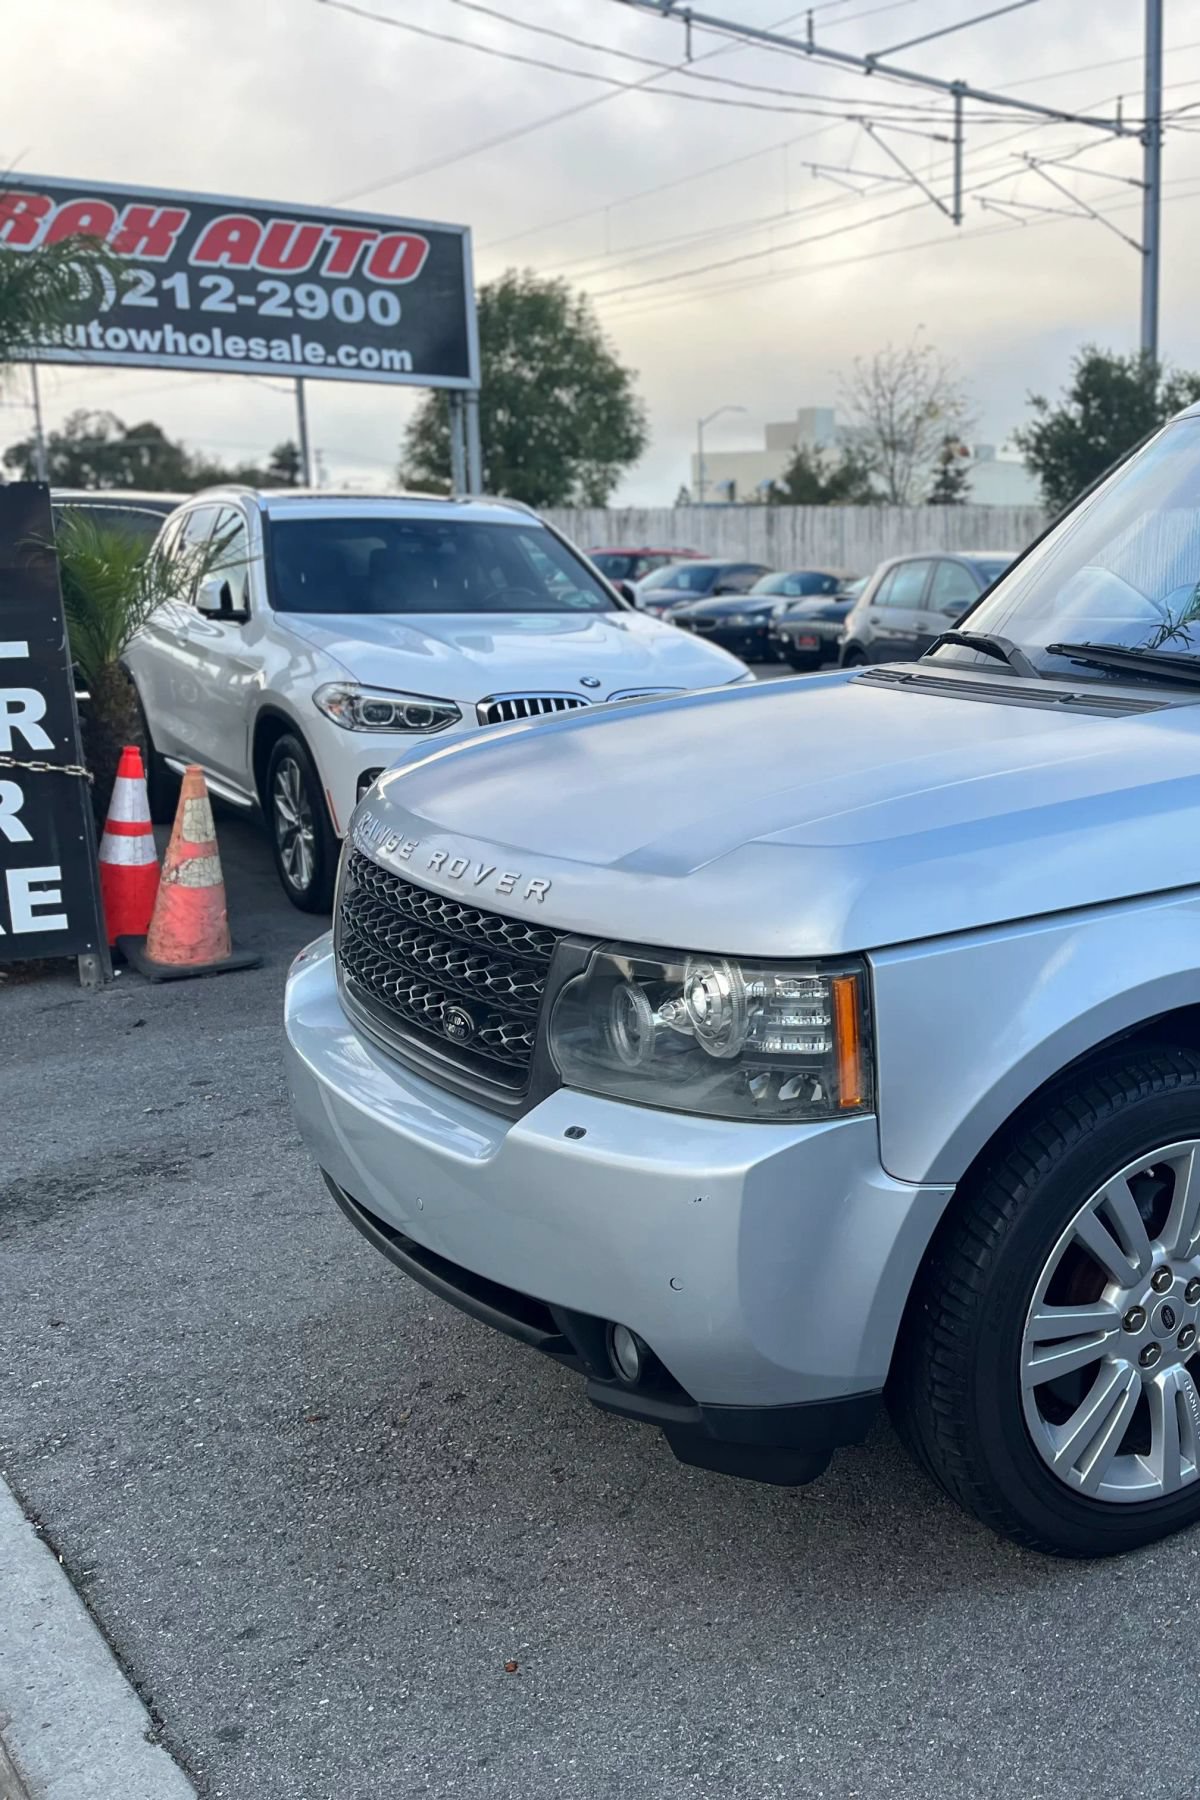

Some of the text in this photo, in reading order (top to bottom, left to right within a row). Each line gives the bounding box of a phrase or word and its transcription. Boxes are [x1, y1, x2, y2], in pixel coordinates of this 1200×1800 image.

[188, 213, 430, 285] AUTO
[357, 811, 553, 903] RANGE ROVER
[0, 865, 68, 935] E
